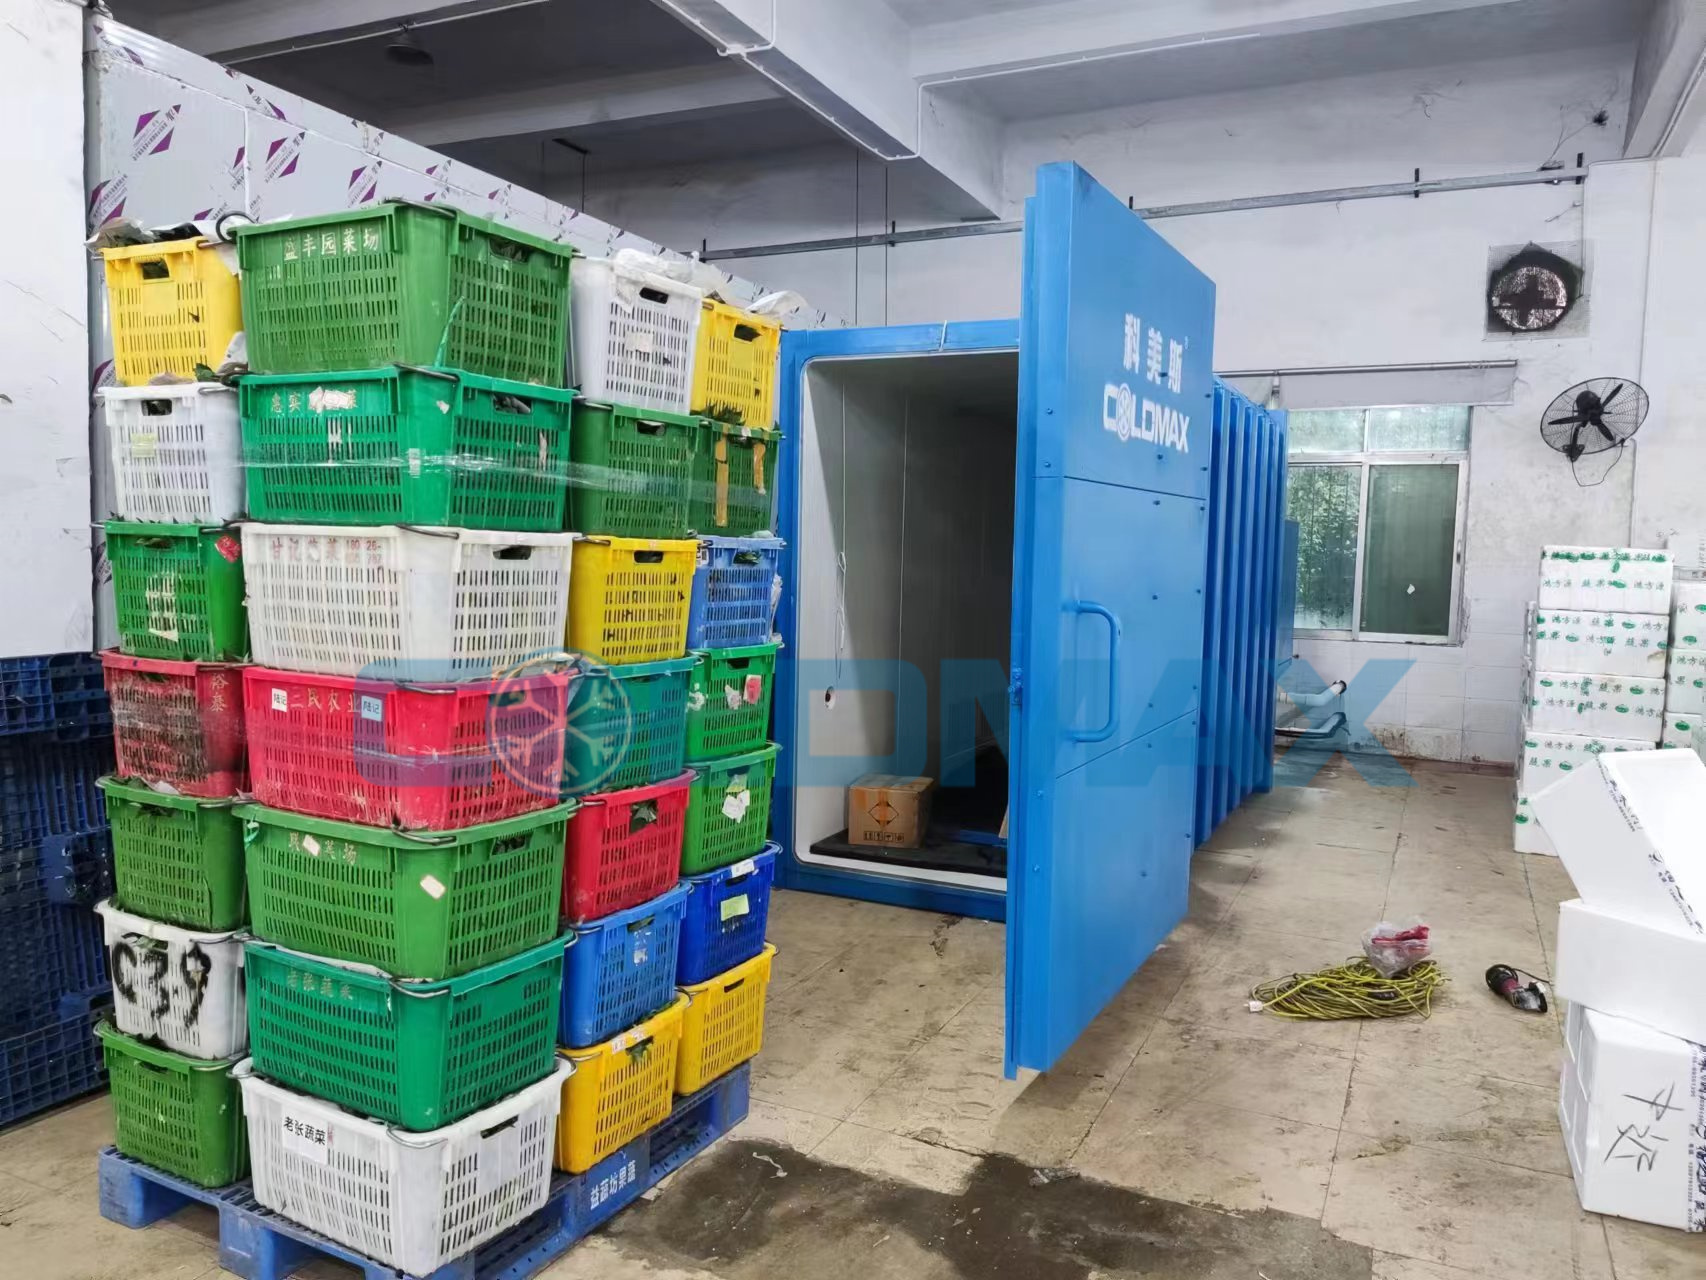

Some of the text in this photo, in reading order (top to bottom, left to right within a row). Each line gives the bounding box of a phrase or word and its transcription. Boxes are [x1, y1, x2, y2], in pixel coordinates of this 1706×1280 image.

[1123, 313, 1183, 394] 科美斯
[1103, 383, 1190, 453] COLDMAX
[283, 1116, 325, 1145] 老张蔬菜
